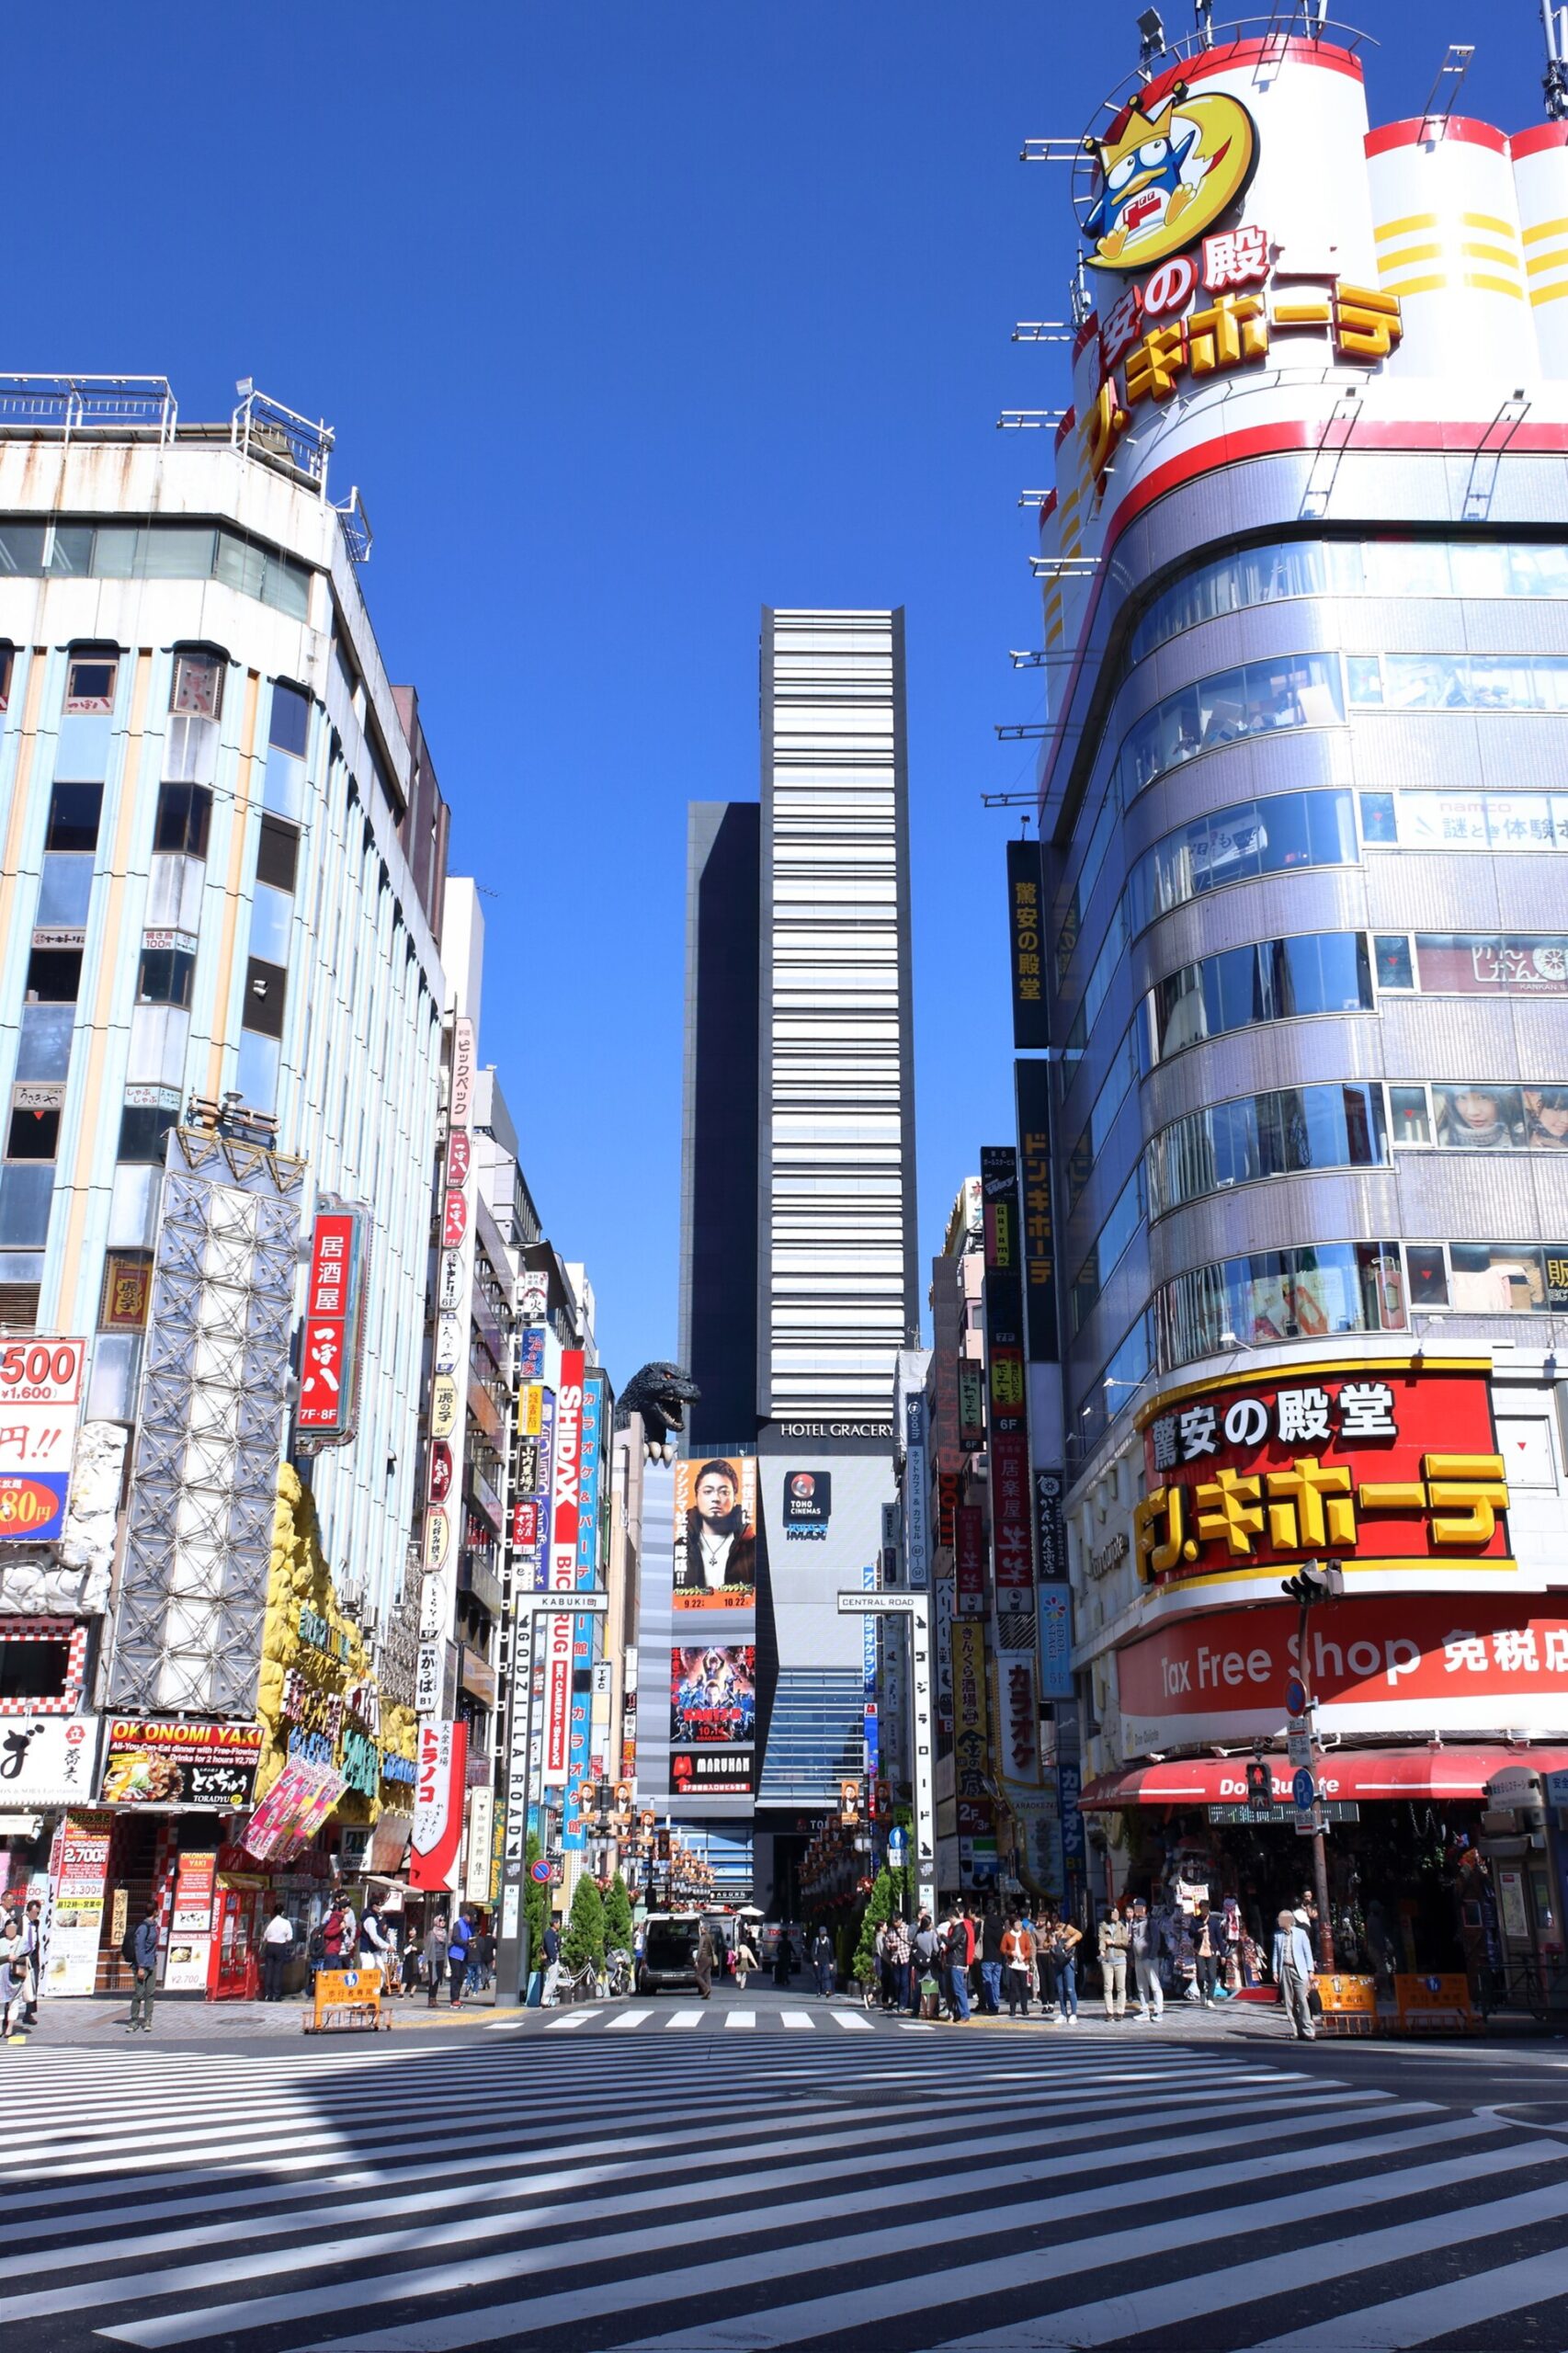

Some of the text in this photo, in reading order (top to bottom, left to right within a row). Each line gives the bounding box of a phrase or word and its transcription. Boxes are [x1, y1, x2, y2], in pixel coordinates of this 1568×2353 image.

[146, 940, 172, 949] 100円
[1016, 882, 1040, 999] 驚安の殿堂
[127, 1088, 151, 1097] しゃぶ
[454, 1040, 471, 1115] ピックペック
[447, 1203, 463, 1233] つぼ八
[315, 1236, 344, 1310] 居酒屋
[119, 1280, 138, 1311] 虎の子
[441, 1298, 456, 1307] 6F
[302, 1328, 339, 1392] つぼ八
[437, 1392, 453, 1423] 虎の子
[781, 1424, 894, 1436] HOTEL GRACERY
[1000, 1419, 1017, 1430] 6F
[1153, 1383, 1398, 1471] 驚安の殿堂
[554, 1385, 582, 1508] SHIDAX
[965, 1440, 978, 1449] 6F
[912, 1450, 920, 1495] ネットカフェ
[431, 1518, 442, 1563] お好み焼き
[542, 1597, 597, 1608] KABUKI町
[552, 1556, 572, 1653] BIC RUG
[843, 1598, 915, 1607] CENTRAL ROAD
[1161, 1656, 1189, 1699] Tax
[1199, 1645, 1271, 1687] Free
[1289, 1630, 1420, 1686] Shop
[1007, 1665, 1036, 1768] カラオケ
[68, 1728, 81, 1740] 立
[113, 1722, 264, 1745] OKONOMI YAKI
[439, 1724, 450, 1767] 大衆酒場
[507, 1632, 529, 1836] GODZILLA ROAD
[169, 1754, 193, 1763] Drinks
[234, 1757, 257, 1766] ¥2,700
[171, 1745, 196, 1754] dinner
[197, 1746, 212, 1755] with
[697, 1757, 750, 1773] MARUHAN
[419, 1729, 438, 1803] トラノコ
[1220, 1777, 1339, 1795] Do Qute
[810, 1820, 827, 1829] TO
[960, 1803, 979, 1821] 2F
[1062, 1768, 1082, 1852] カラオケ
